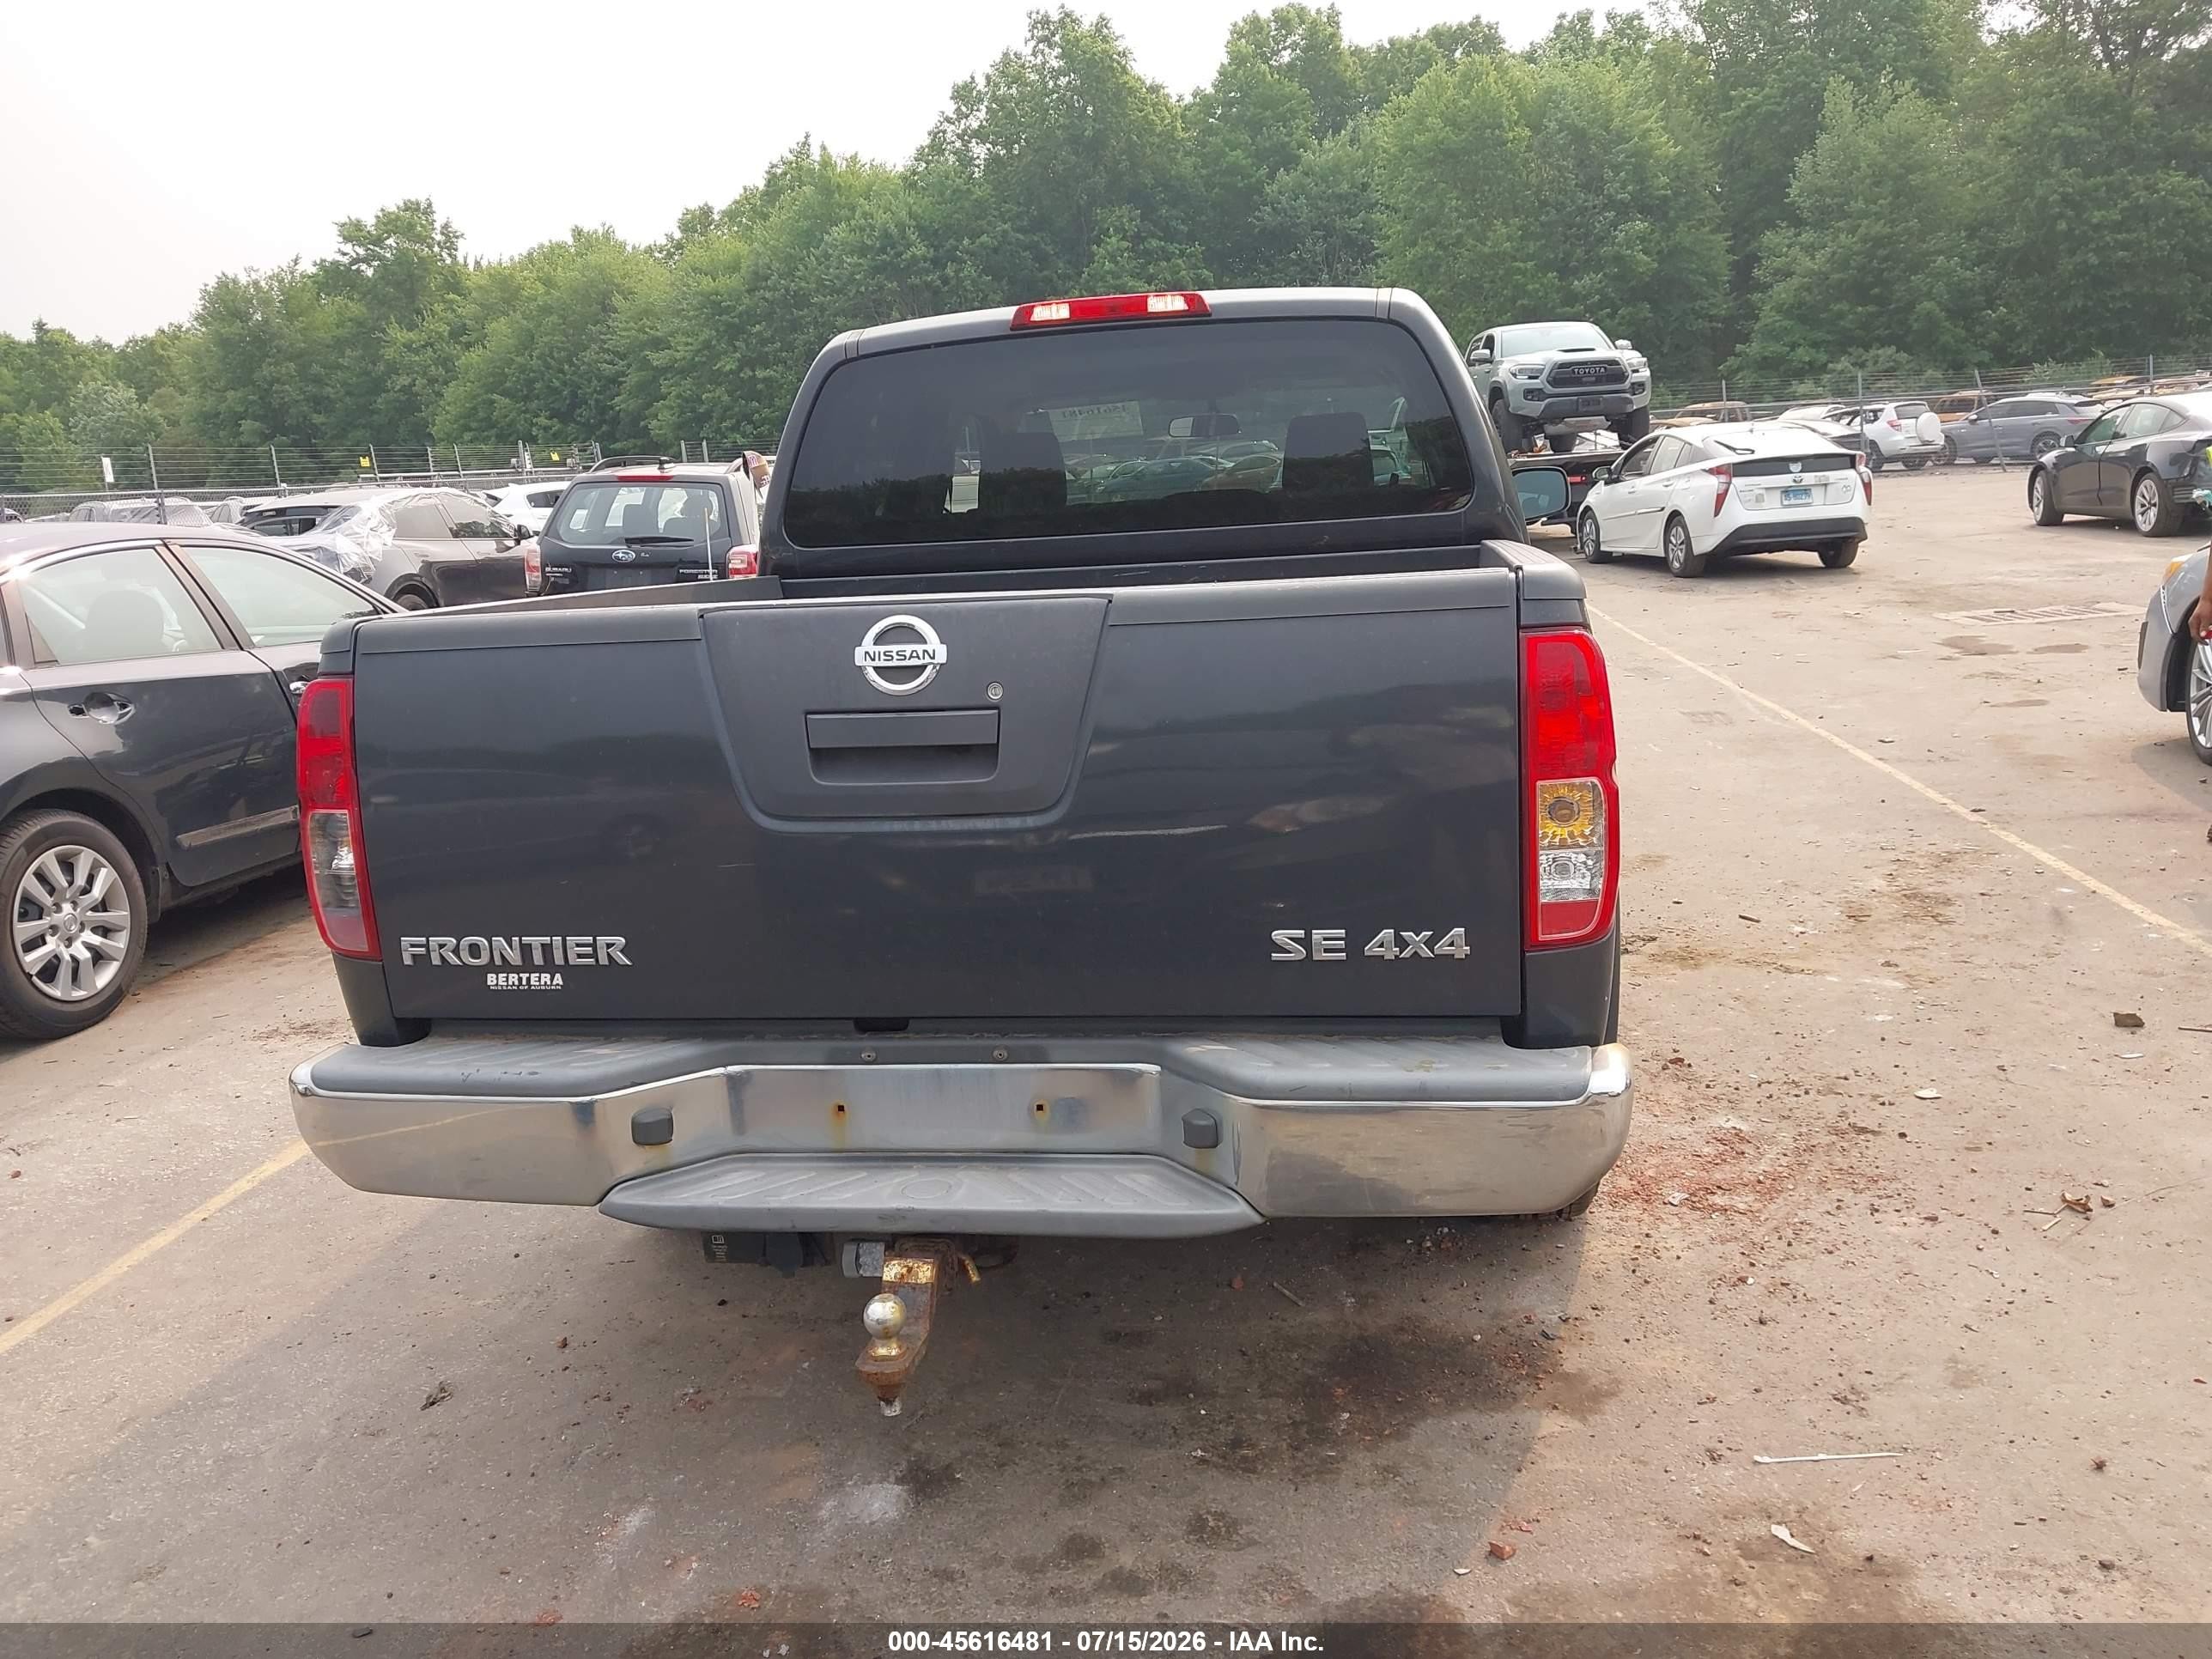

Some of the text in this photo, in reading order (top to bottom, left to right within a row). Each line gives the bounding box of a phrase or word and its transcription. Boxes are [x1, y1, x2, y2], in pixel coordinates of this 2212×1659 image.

[864, 648, 936, 662] NISSAN
[400, 936, 633, 966] FRONTIER
[1271, 929, 1346, 961] SE
[487, 973, 563, 986] BERTERA
